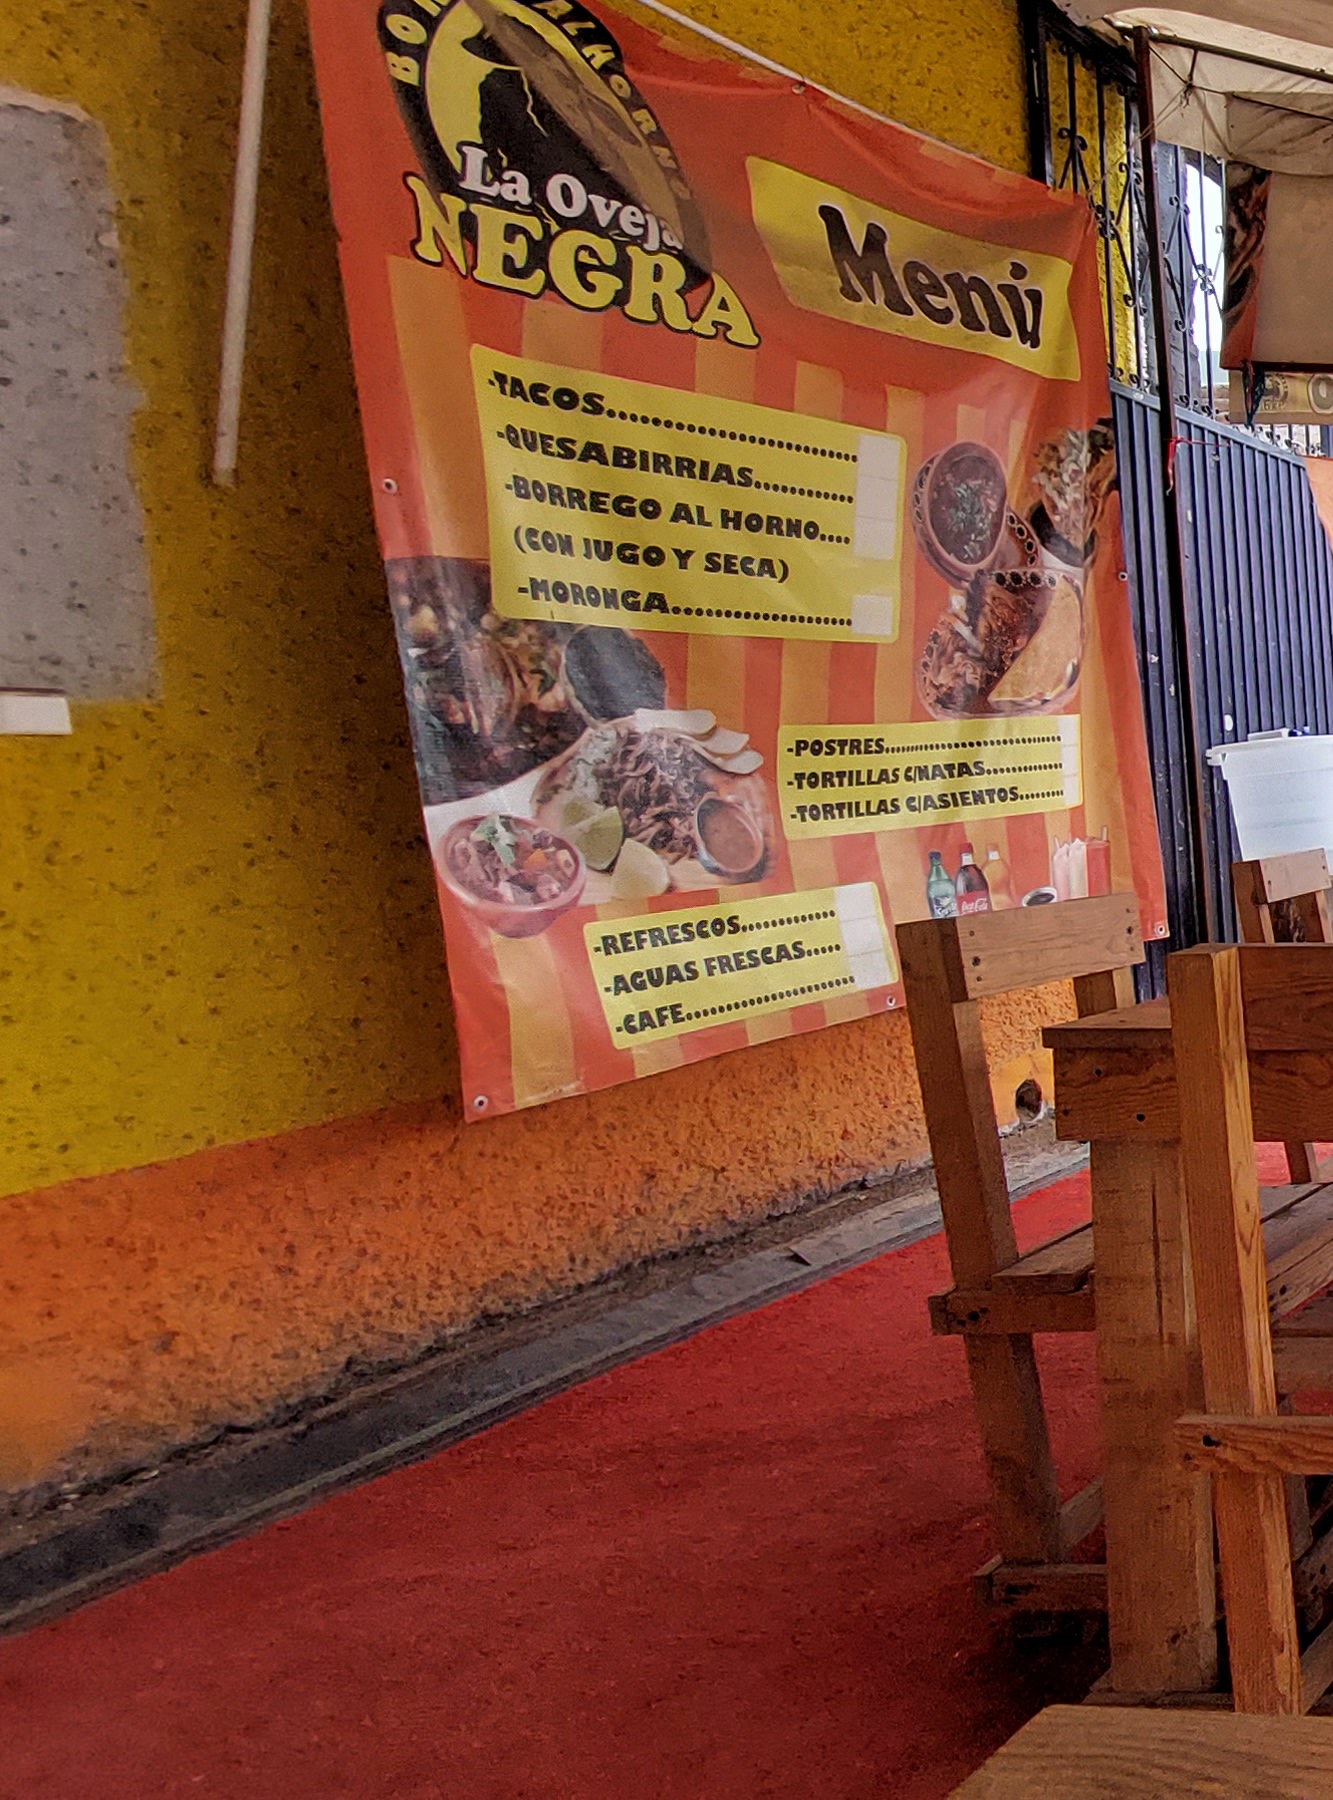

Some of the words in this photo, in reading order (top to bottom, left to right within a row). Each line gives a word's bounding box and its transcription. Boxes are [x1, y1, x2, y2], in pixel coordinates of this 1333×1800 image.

[458, 146, 533, 206] La
[546, 173, 683, 250] Oveja
[405, 174, 760, 347] NEGRA
[818, 205, 1043, 349] Menú
[513, 525, 575, 557] (CON
[583, 538, 667, 567] JUGO
[672, 547, 697, 570] Y
[704, 552, 788, 583] SECA)
[669, 503, 712, 528] AL
